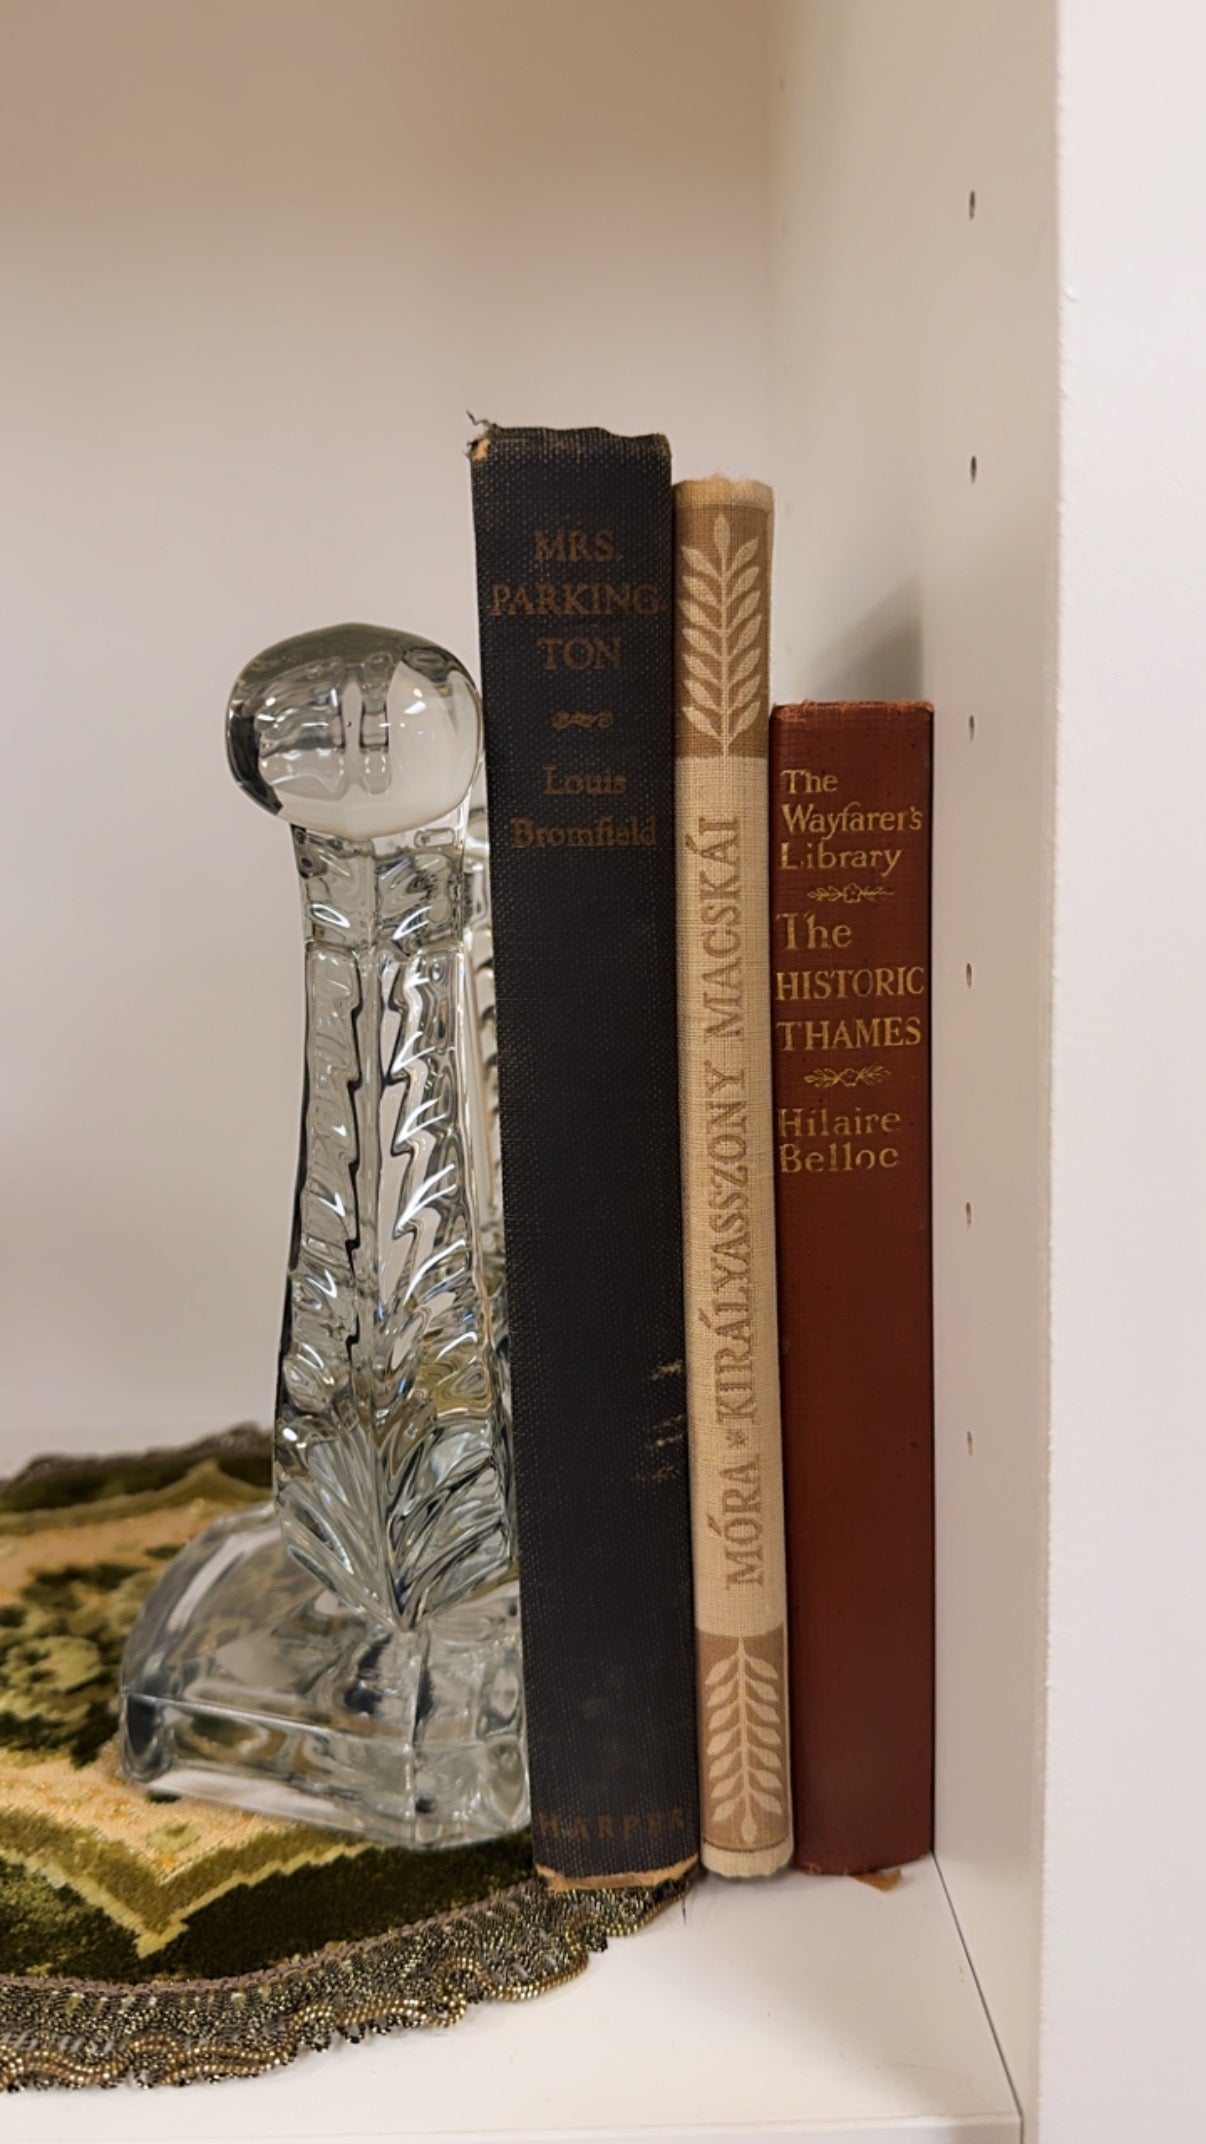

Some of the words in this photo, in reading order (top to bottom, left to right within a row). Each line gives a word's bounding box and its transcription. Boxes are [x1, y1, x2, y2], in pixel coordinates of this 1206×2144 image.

[533, 529, 623, 562] MRS.
[536, 636, 621, 670] TON
[543, 763, 628, 796] Louis
[780, 770, 838, 793] The
[510, 815, 657, 849] Bromfield
[782, 802, 922, 840] Wayfarer's
[780, 842, 902, 877] Library
[685, 817, 743, 1043] MACSKÁI
[776, 912, 853, 950] The
[777, 967, 924, 1000] HISTORIC
[777, 1017, 921, 1051] THAMES
[778, 1107, 900, 1137] Hilaire
[779, 1143, 899, 1174] Belloc
[699, 1060, 757, 1424] KIRÁLYASSZONY
[706, 1454, 763, 1590] MÓRA
